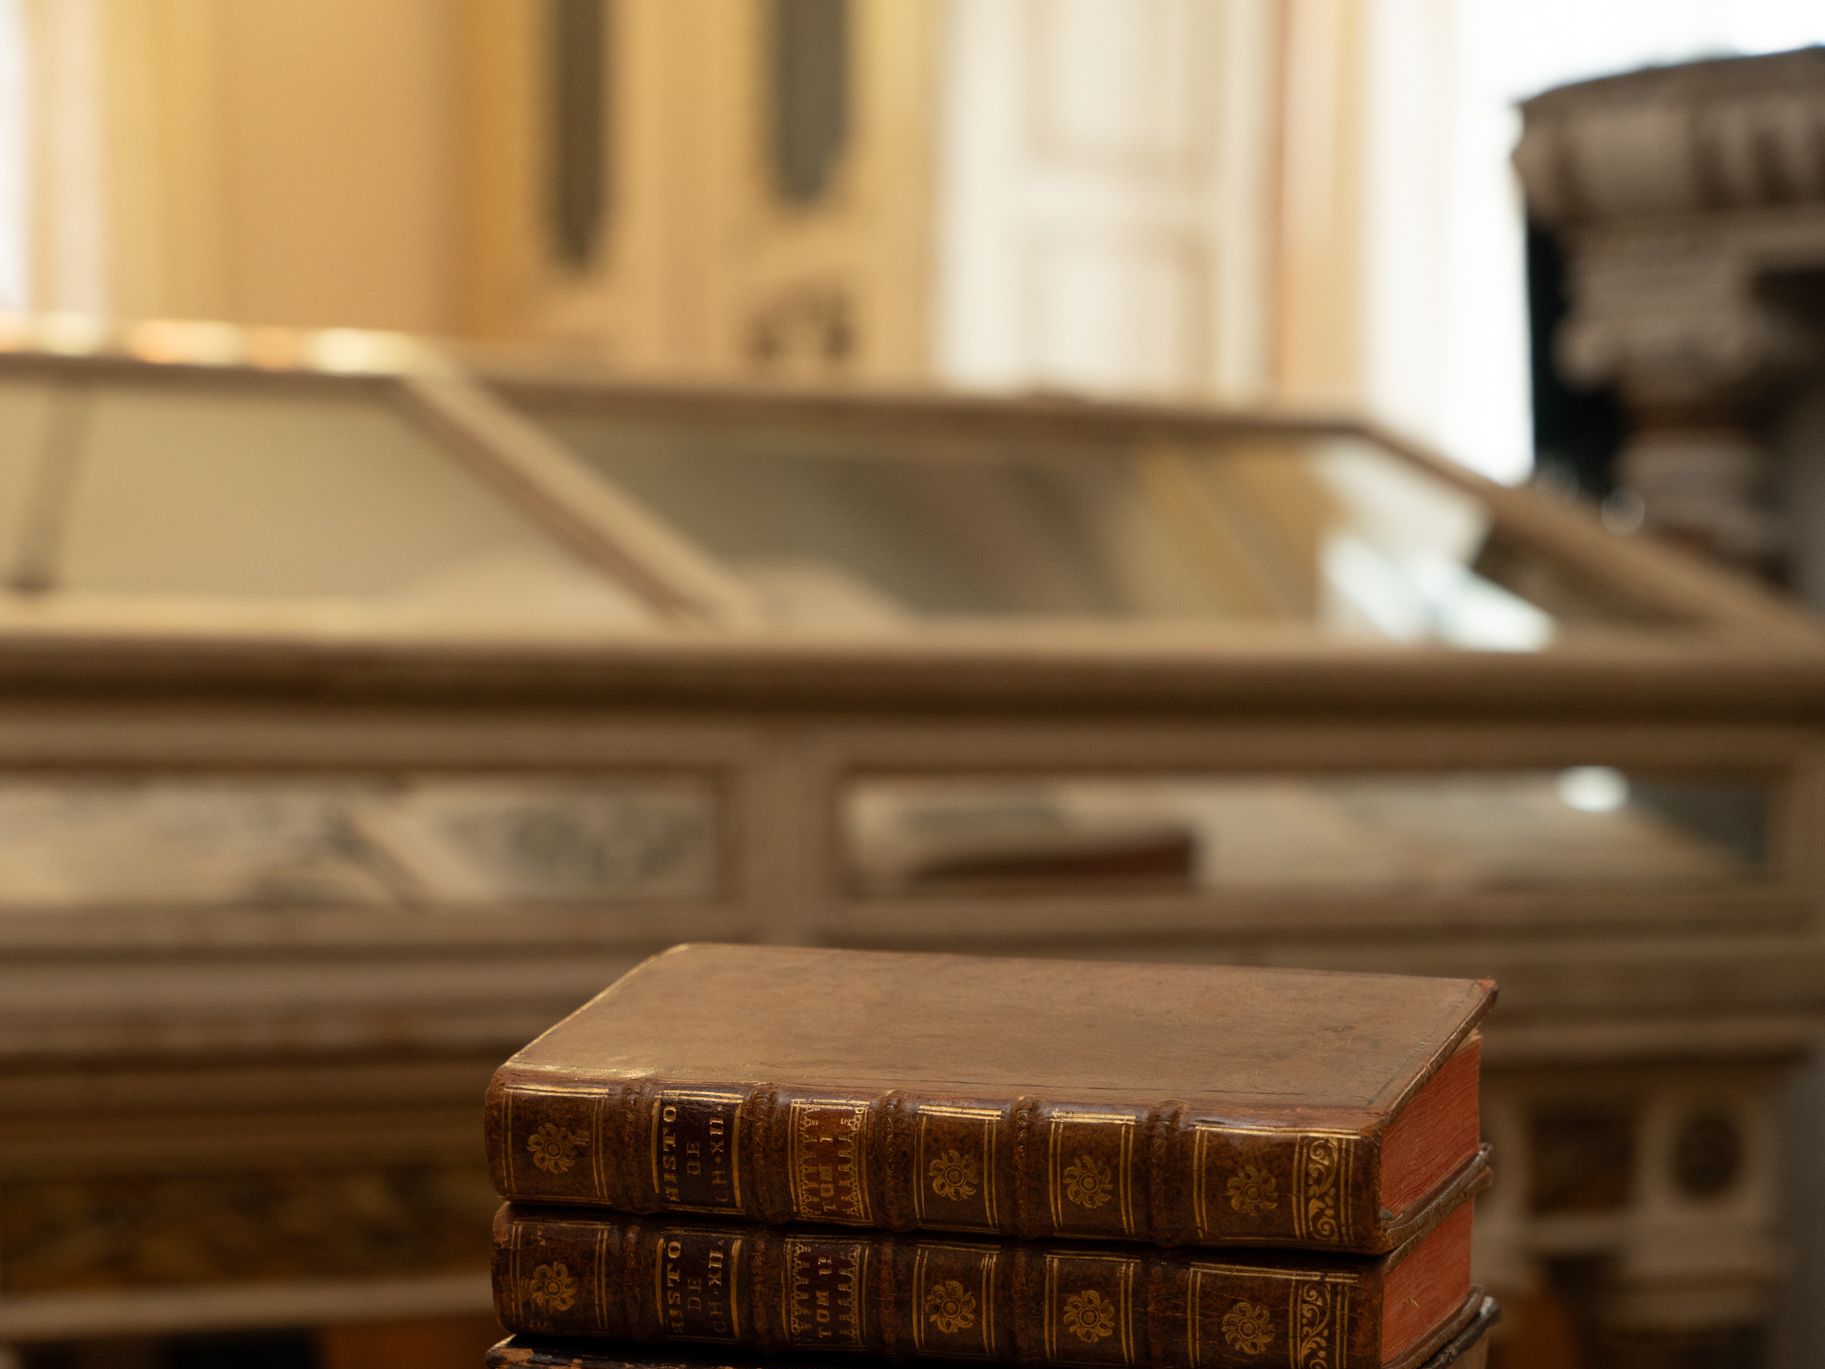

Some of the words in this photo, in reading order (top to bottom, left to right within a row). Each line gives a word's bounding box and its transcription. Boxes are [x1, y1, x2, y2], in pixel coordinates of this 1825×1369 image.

[686, 1142, 700, 1176] DE
[688, 1279, 701, 1311] DE
[816, 1291, 833, 1338] TOM
